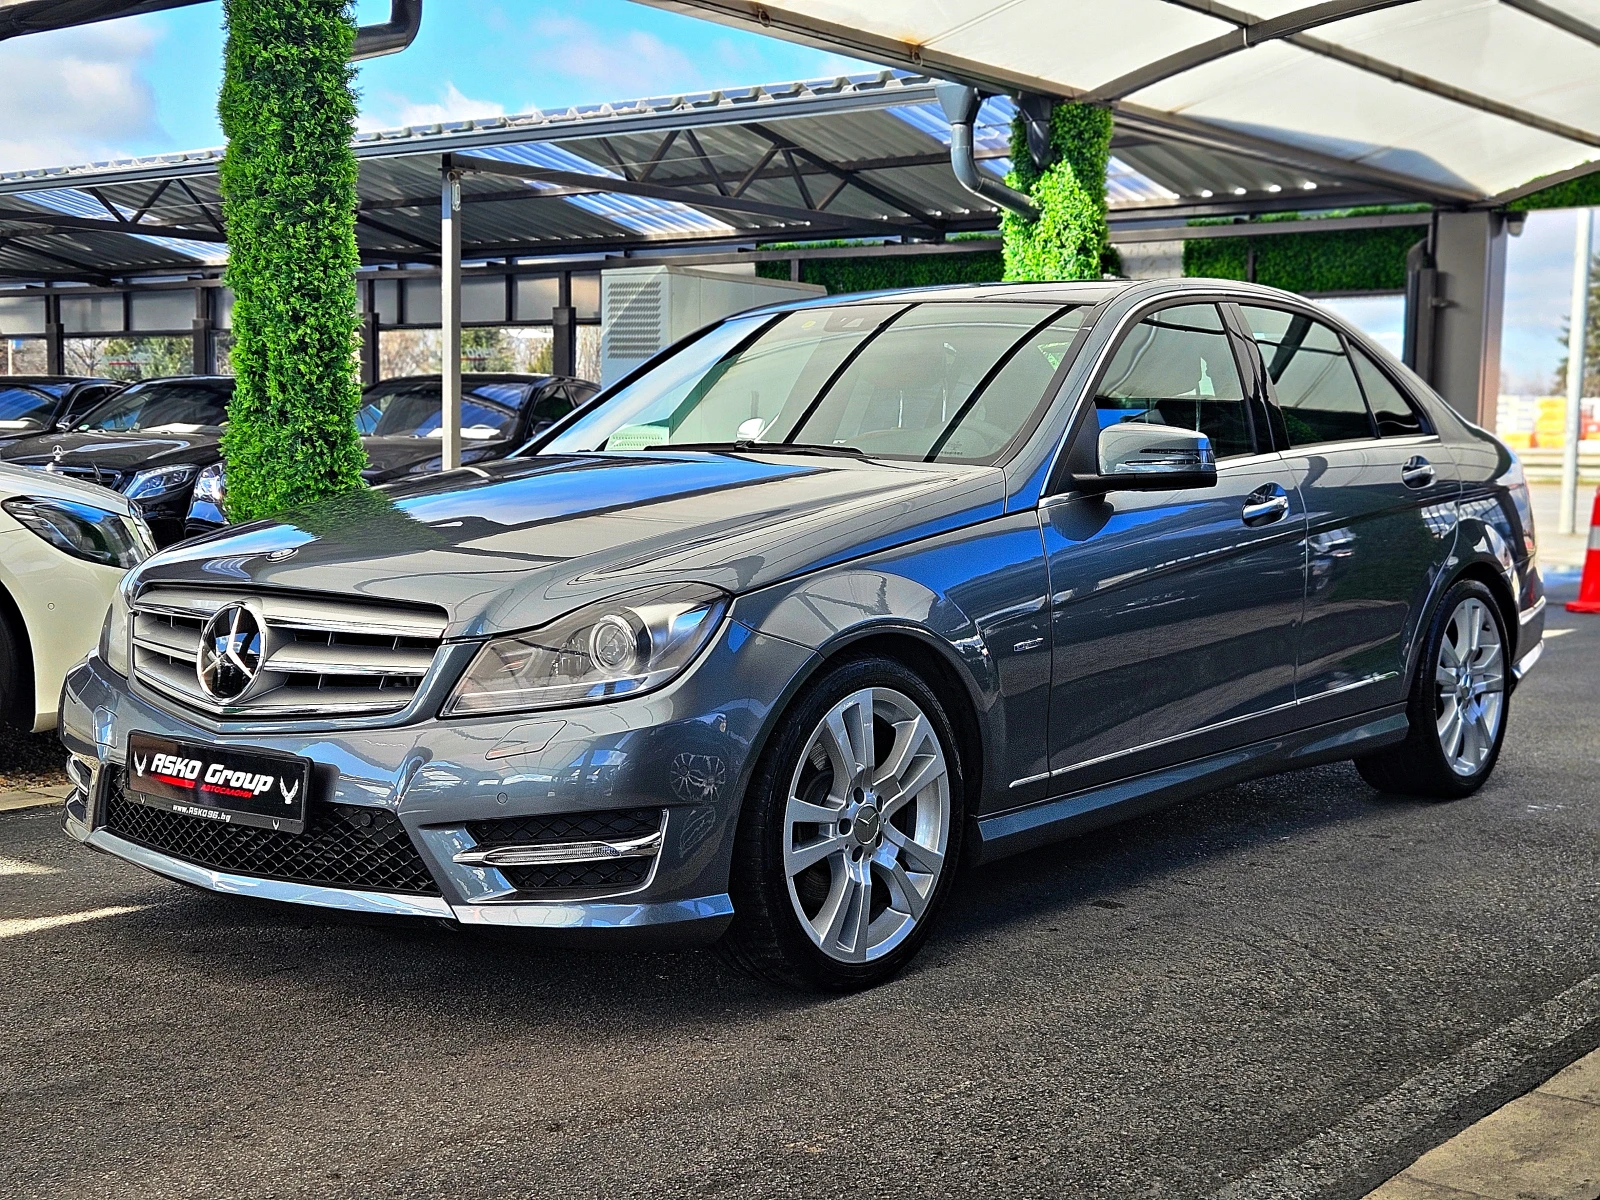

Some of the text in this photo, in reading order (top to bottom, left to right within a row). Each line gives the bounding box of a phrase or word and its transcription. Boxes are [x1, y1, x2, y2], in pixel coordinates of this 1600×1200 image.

[150, 753, 274, 795] ASKO Group
[172, 804, 231, 822] www.ASKO96.bg
